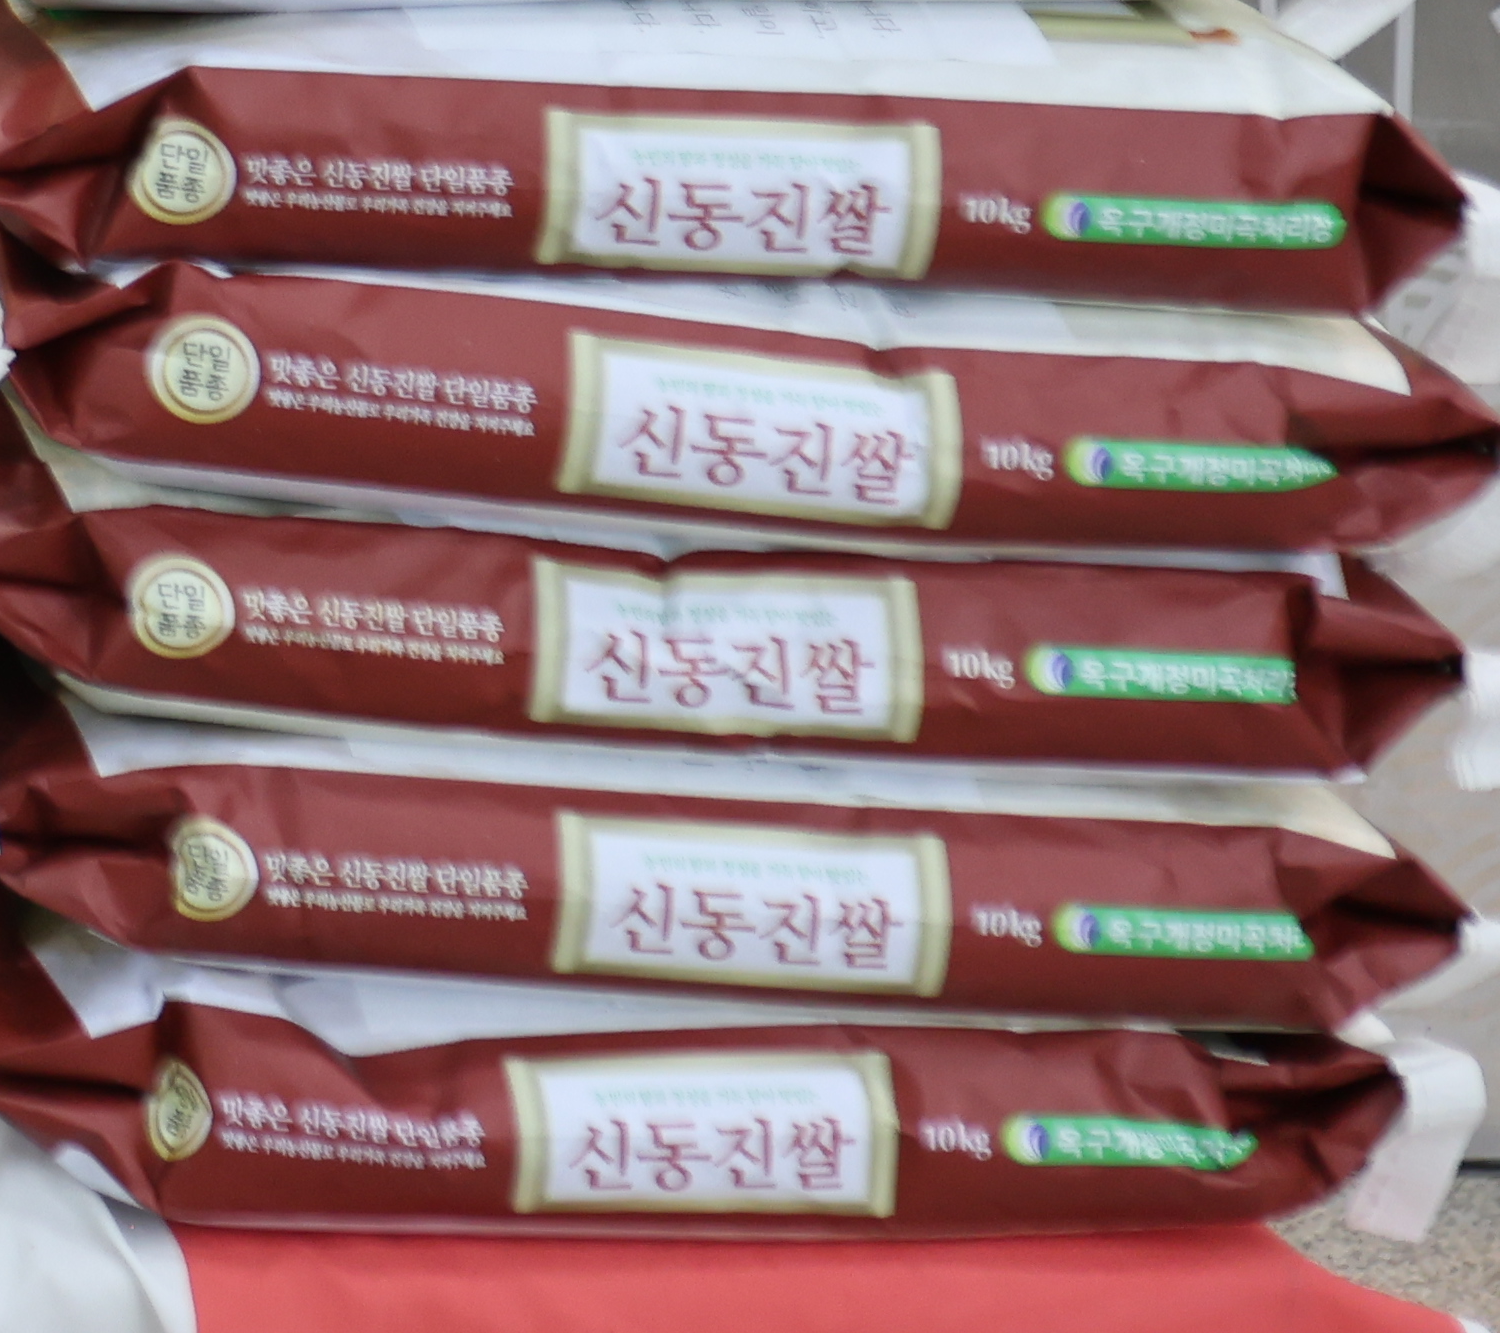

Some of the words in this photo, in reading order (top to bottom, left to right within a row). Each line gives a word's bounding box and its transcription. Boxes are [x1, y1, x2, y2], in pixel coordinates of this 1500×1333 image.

[595, 177, 889, 256] 신동진쌀
[964, 196, 1030, 233] 10kg
[620, 406, 907, 506] 신동진쌀
[985, 441, 1053, 480] 10kg
[590, 630, 872, 715] 신동진쌀
[947, 650, 1015, 689] 10kg
[618, 883, 899, 969] 신동진쌀
[975, 905, 1041, 946] 10kg
[570, 1118, 853, 1193] 신동진쌀
[925, 1121, 991, 1159] 10kg
